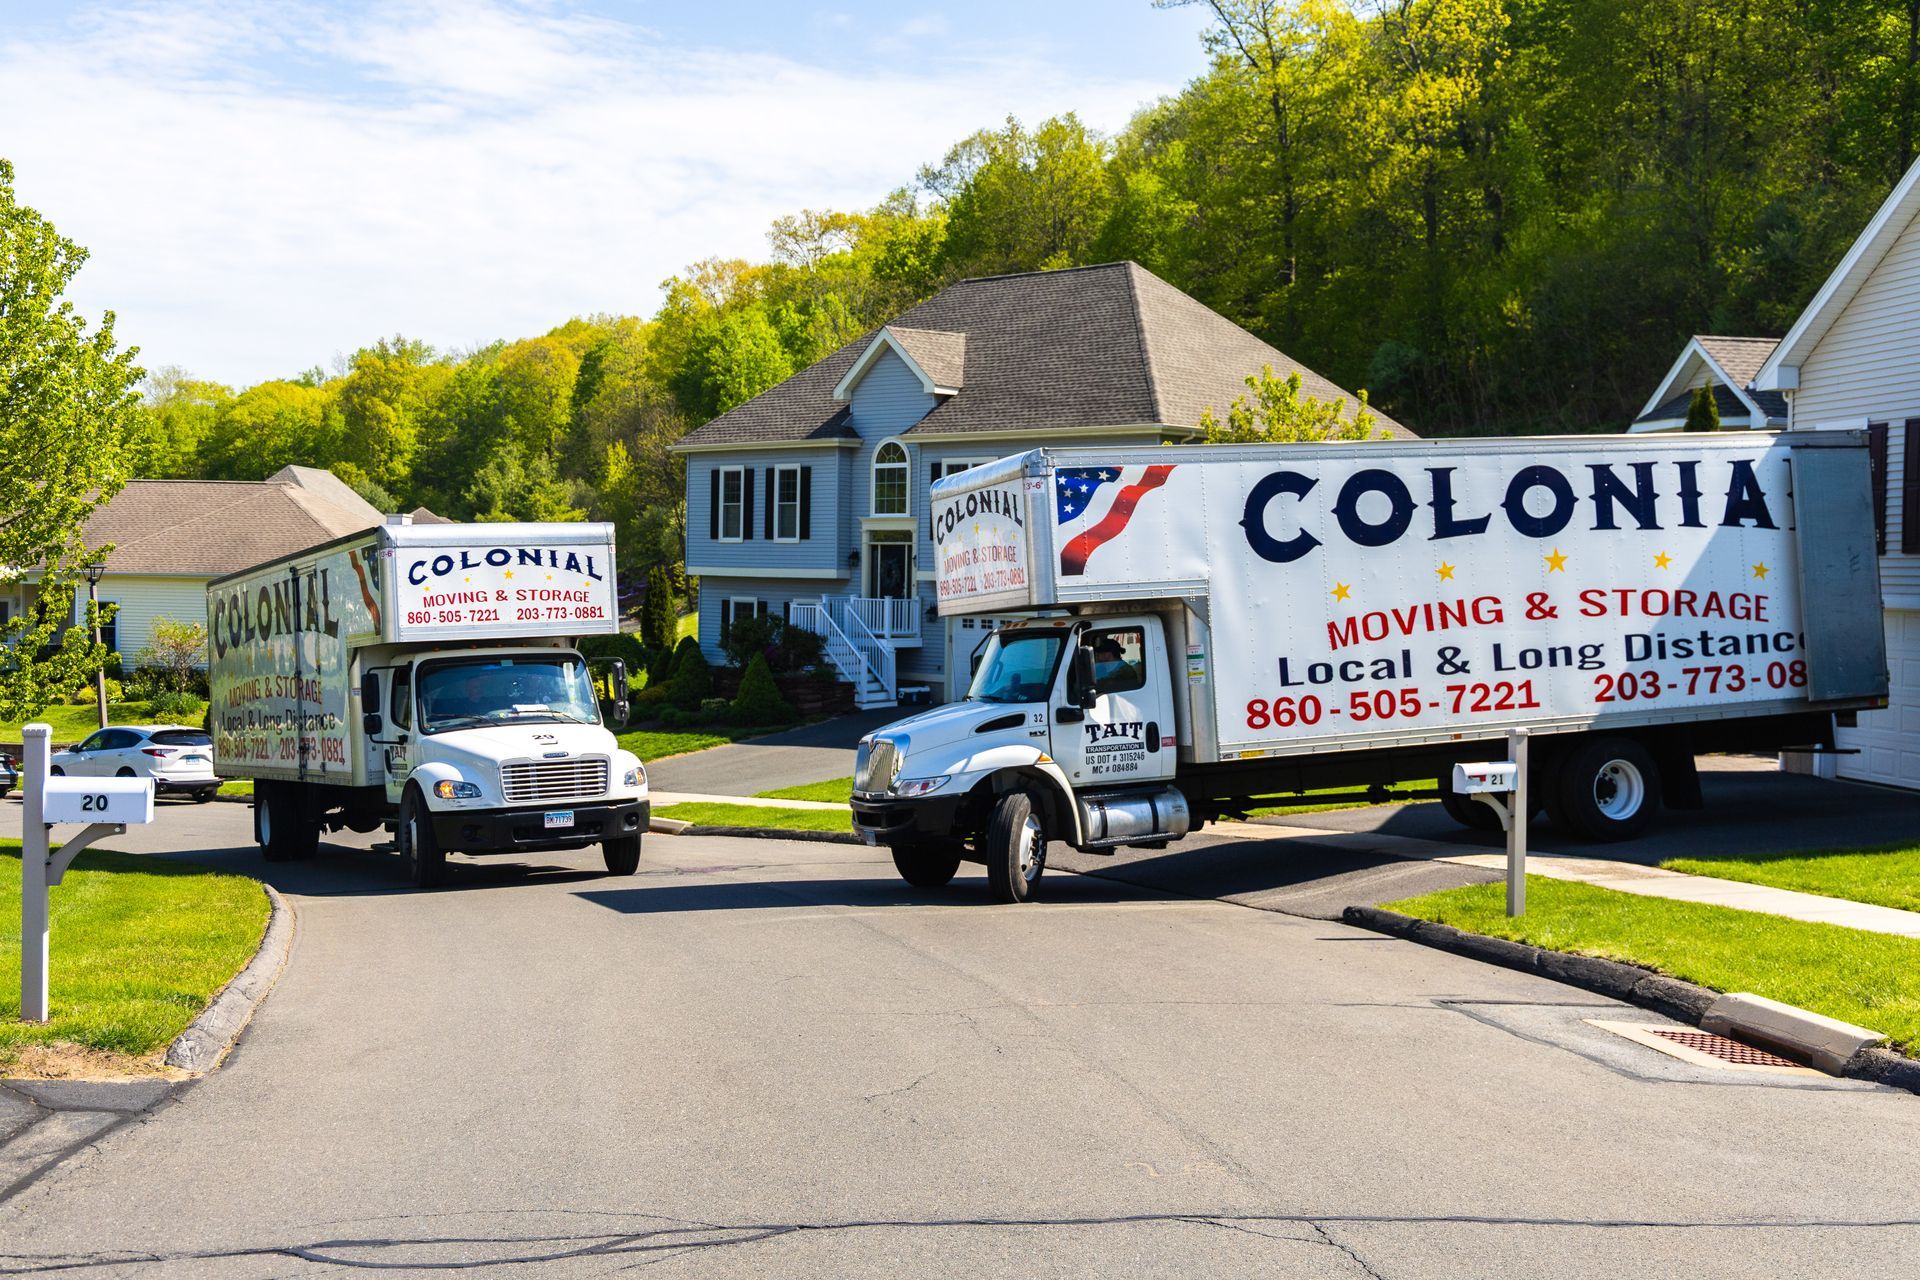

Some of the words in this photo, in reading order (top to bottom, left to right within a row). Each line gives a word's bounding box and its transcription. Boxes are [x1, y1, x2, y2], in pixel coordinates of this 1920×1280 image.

[936, 489, 1023, 546] COLONIAL
[1238, 458, 1796, 563] COLONIA
[407, 548, 603, 586] COLONIAL
[943, 549, 971, 575] MOVING
[972, 548, 979, 565] &
[981, 545, 1017, 563] STORAGE
[422, 590, 488, 608] MOVING
[495, 589, 508, 602] &
[516, 588, 590, 603] STORAGE
[214, 567, 340, 660] COLONIAL
[407, 608, 500, 625] 860-505-7221
[516, 606, 605, 621] 203-773-0881
[1326, 595, 1505, 651] MOVING
[1524, 591, 1559, 620] &
[1578, 588, 1770, 623] STORAGE
[1278, 648, 1413, 688] Local
[1436, 646, 1471, 676] &
[1492, 642, 1606, 671] Long
[1624, 629, 1806, 663] Distanc
[229, 678, 261, 709] MOVING
[264, 676, 273, 699] &
[275, 675, 323, 705] STORAGE
[1246, 679, 1541, 730] 860-505-7221
[1593, 659, 1808, 703] 203-773-08
[222, 710, 245, 732] Local
[247, 710, 255, 732] &
[257, 708, 283, 736] Long
[285, 709, 336, 733] Distance
[1085, 721, 1143, 744] TAIT
[1085, 755, 1095, 765] US
[1097, 754, 1111, 765] DOT
[1113, 754, 1118, 762] #
[1087, 743, 1140, 753] TRANSPORTATION
[1092, 765, 1104, 775] MC
[1491, 774, 1504, 785] 21
[82, 794, 109, 811] 20
